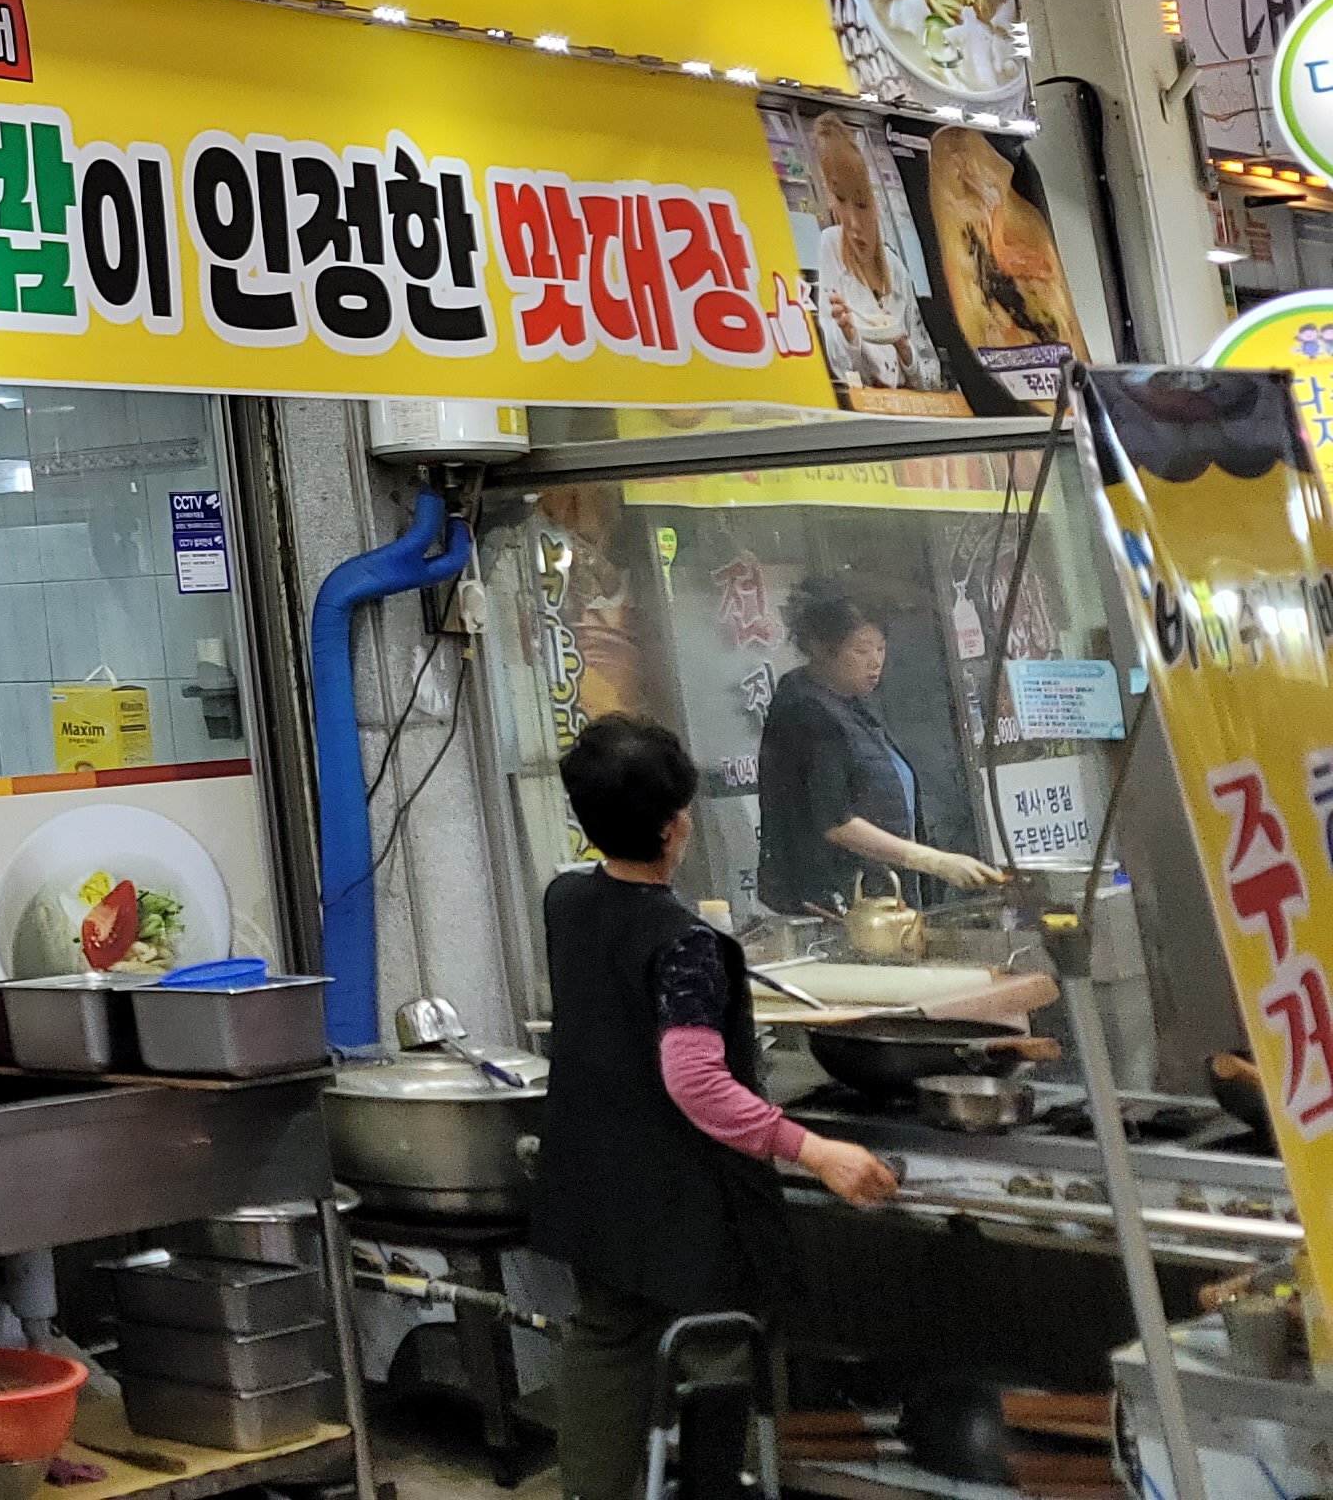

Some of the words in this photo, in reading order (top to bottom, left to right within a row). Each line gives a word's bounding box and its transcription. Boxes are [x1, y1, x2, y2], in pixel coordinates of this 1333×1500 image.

[193, 145, 488, 340] 인정한
[495, 182, 766, 354] 맛대장
[174, 496, 202, 509] CCTV
[61, 721, 105, 736] Maxim
